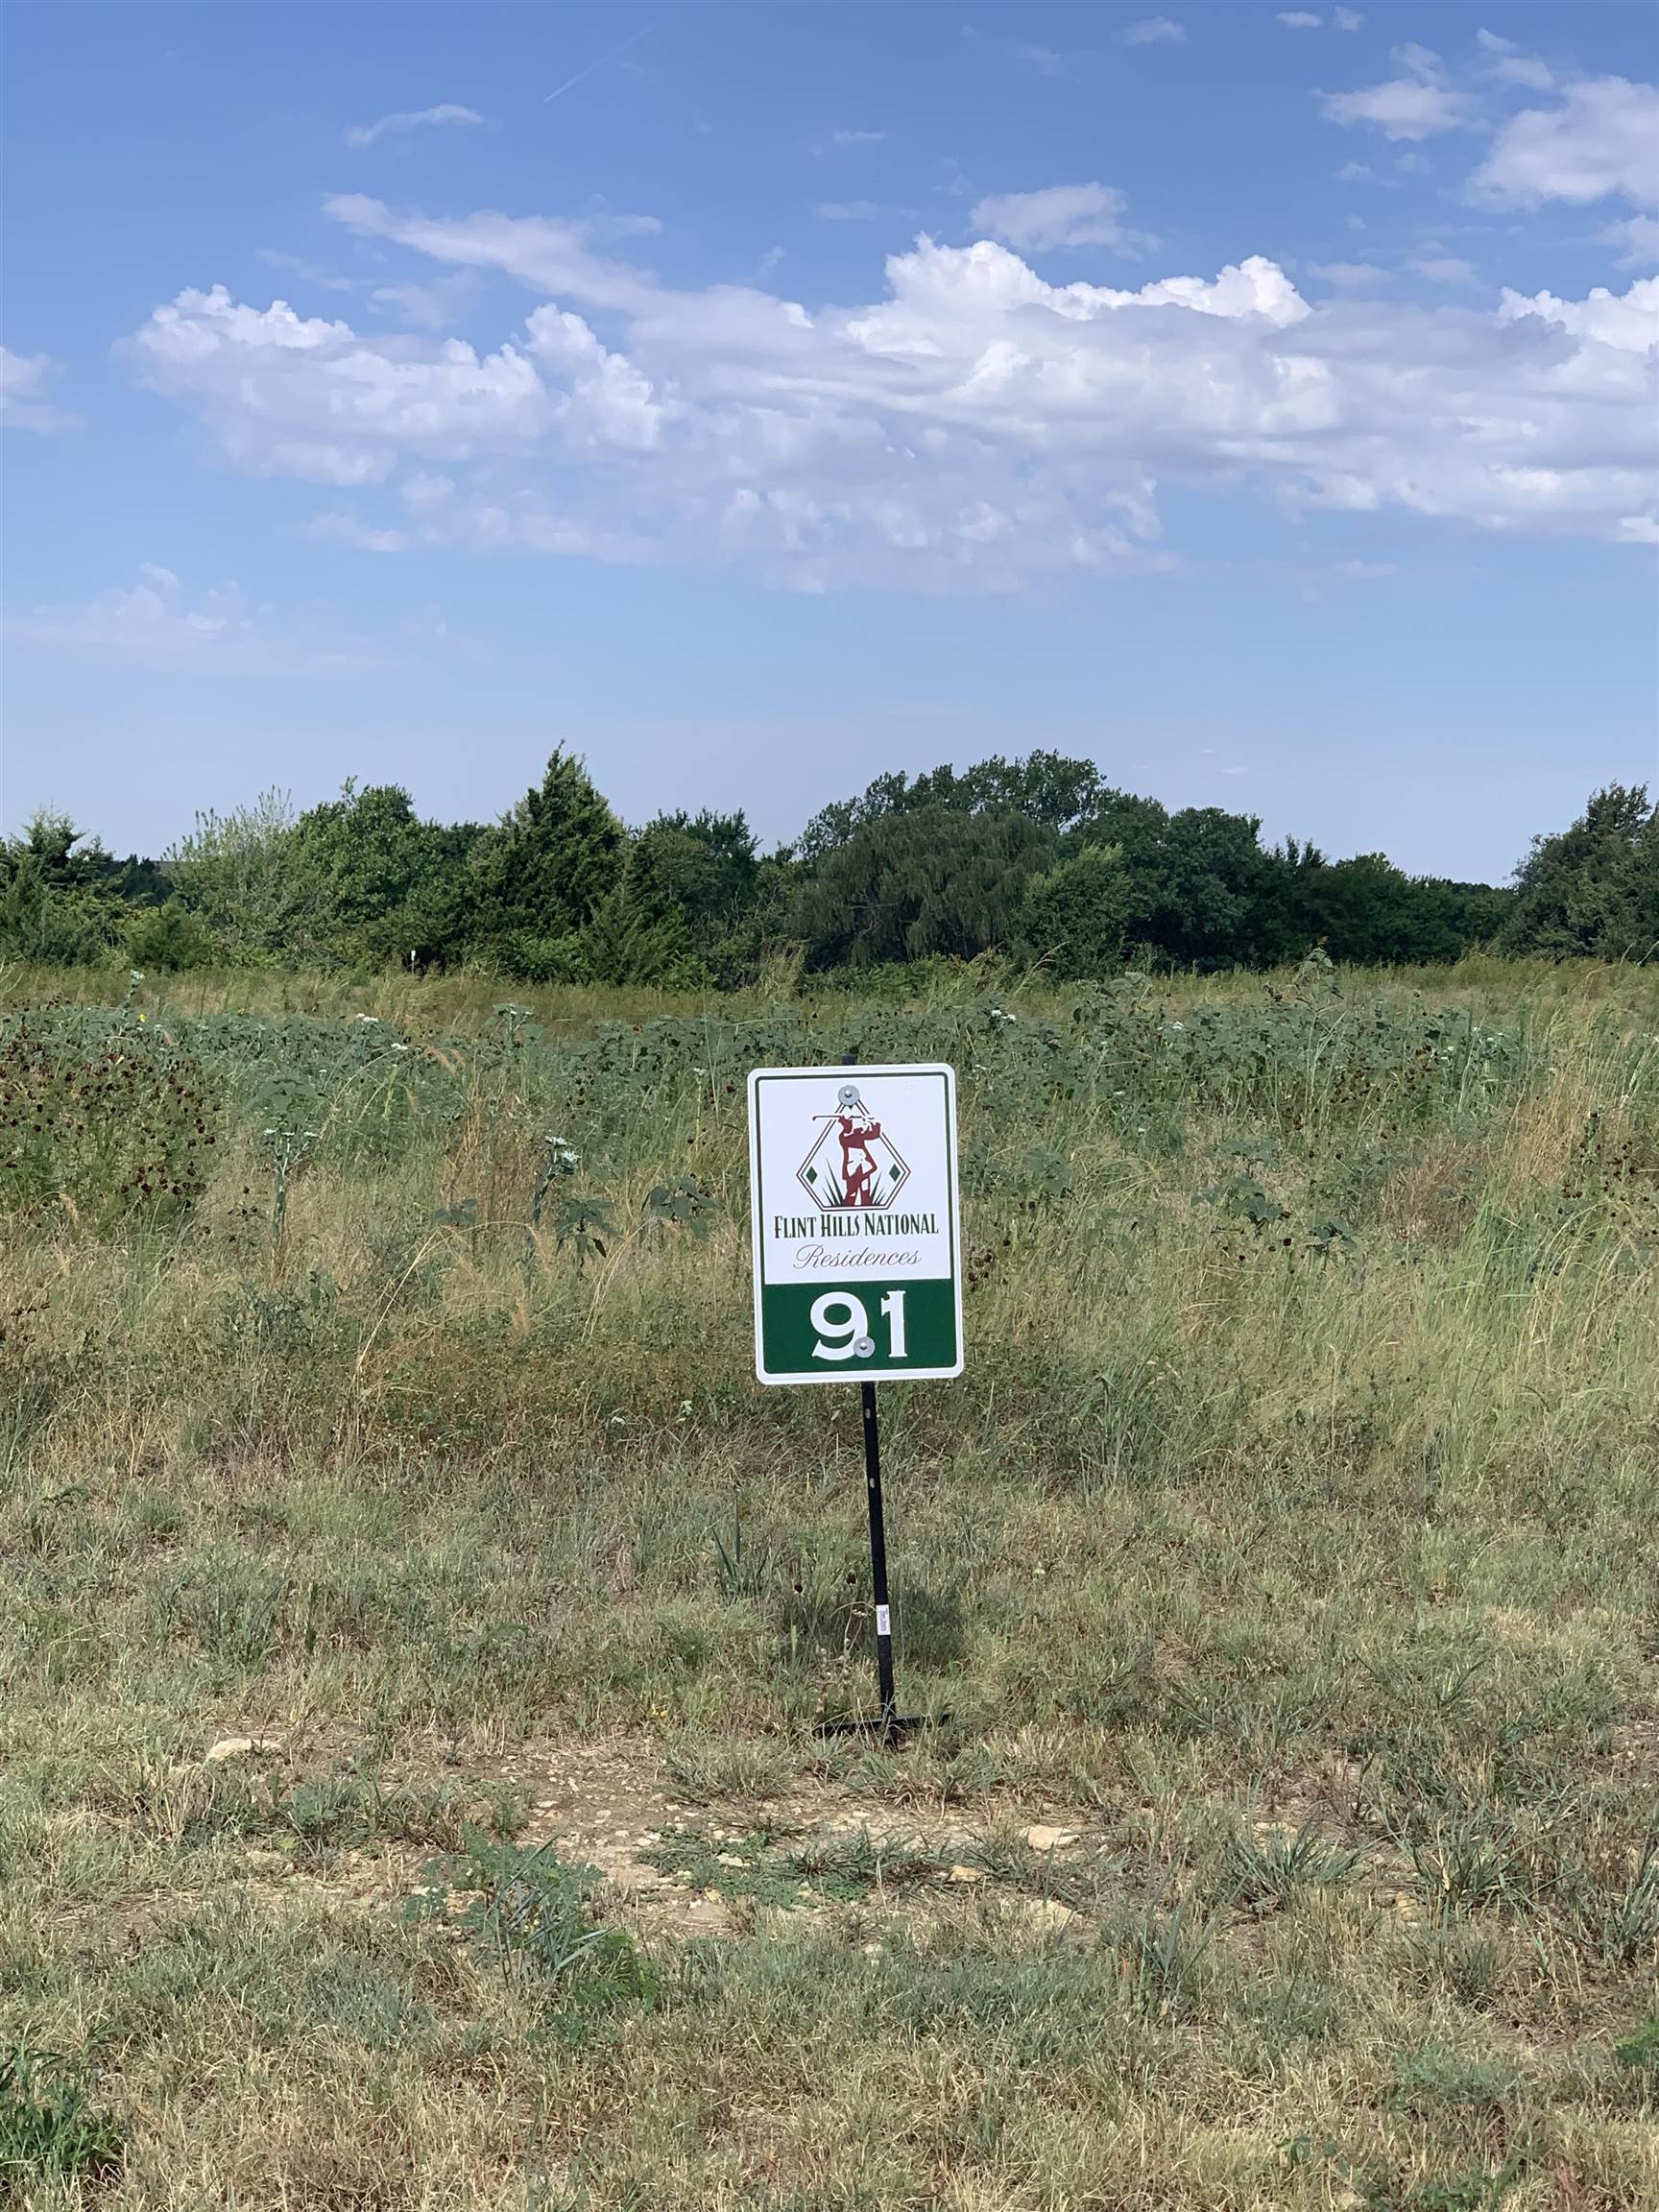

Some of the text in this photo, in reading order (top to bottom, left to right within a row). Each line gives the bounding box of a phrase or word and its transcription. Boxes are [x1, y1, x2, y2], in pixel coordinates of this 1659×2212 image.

[774, 1213, 939, 1238] FLINT HILLS NATIONAL
[793, 1243, 922, 1269] Residences
[810, 1290, 908, 1360] 91
